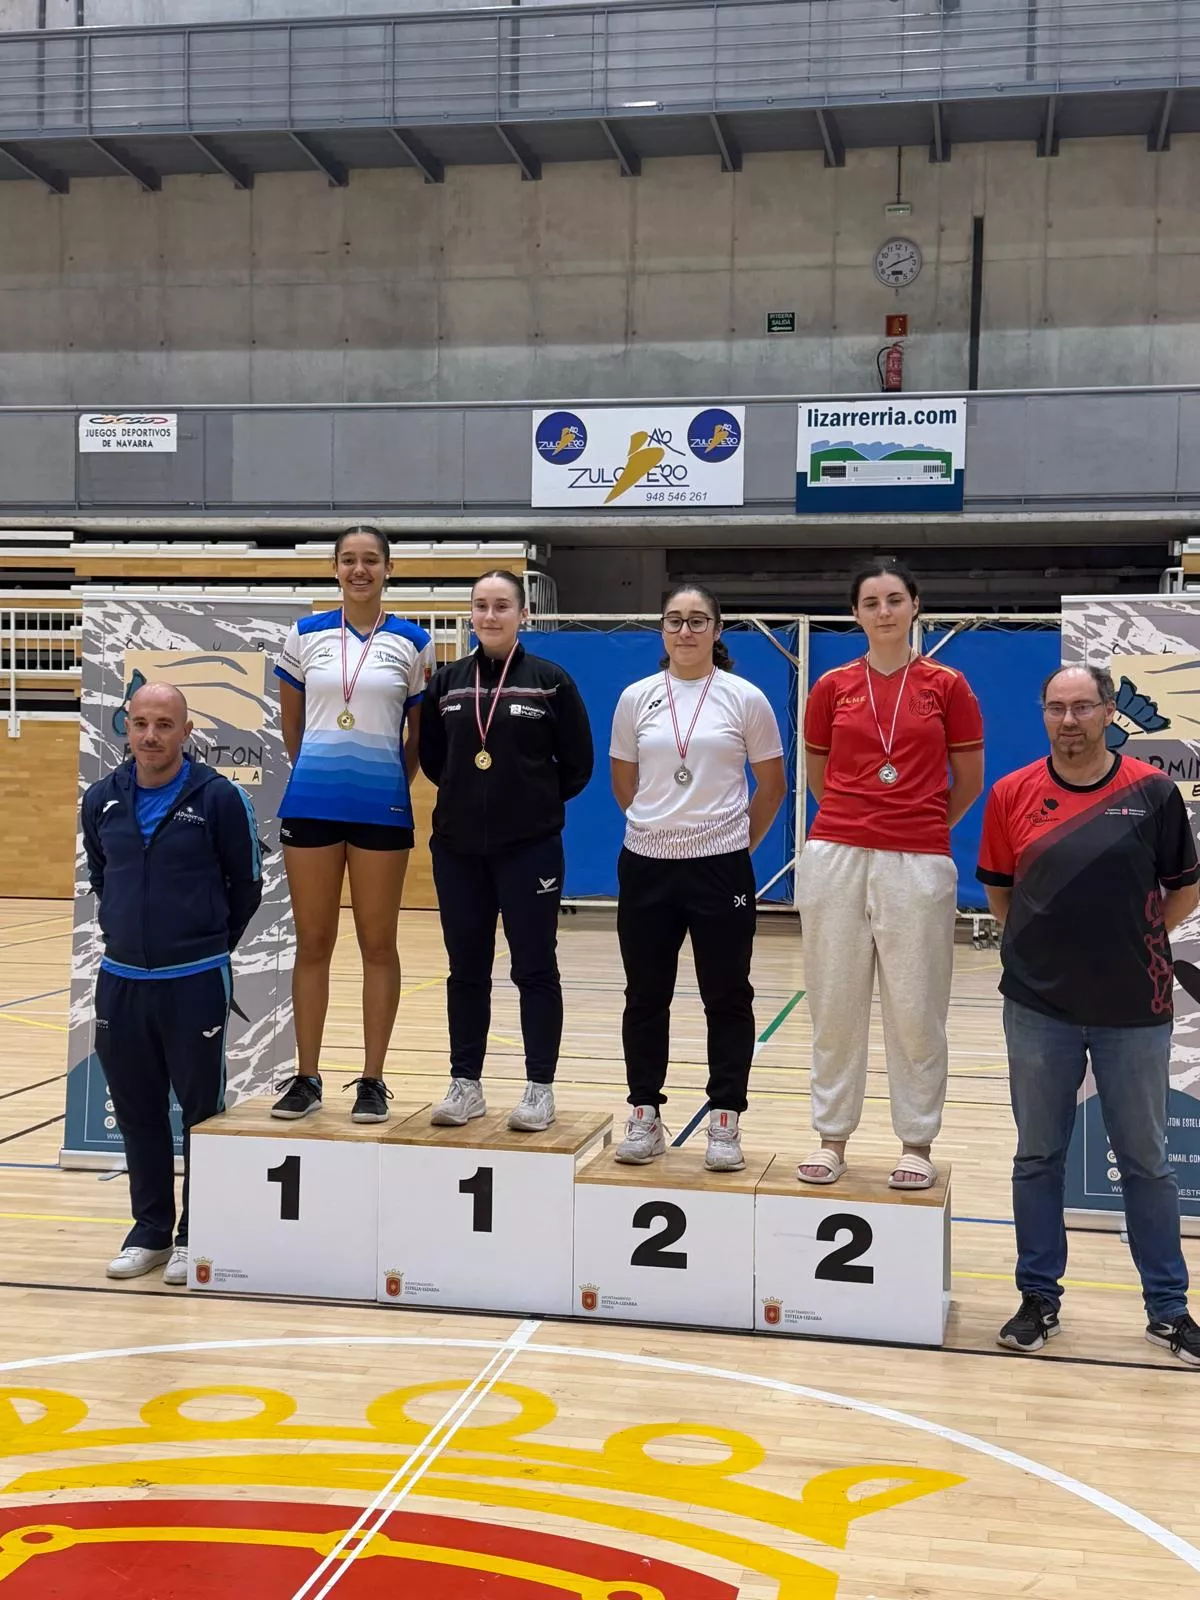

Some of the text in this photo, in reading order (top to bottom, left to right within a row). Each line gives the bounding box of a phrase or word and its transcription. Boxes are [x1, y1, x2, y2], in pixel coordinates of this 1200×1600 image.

[85, 428, 171, 437] JUEGOS DEPORTIVOS
[807, 406, 957, 428] lizarrerria.com
[102, 439, 154, 447] DE NAVARRA
[646, 491, 708, 502] 948 546 261
[267, 1155, 301, 1221] 1
[458, 1166, 494, 1233] 1
[630, 1200, 688, 1270] 2
[814, 1212, 875, 1285] 2
